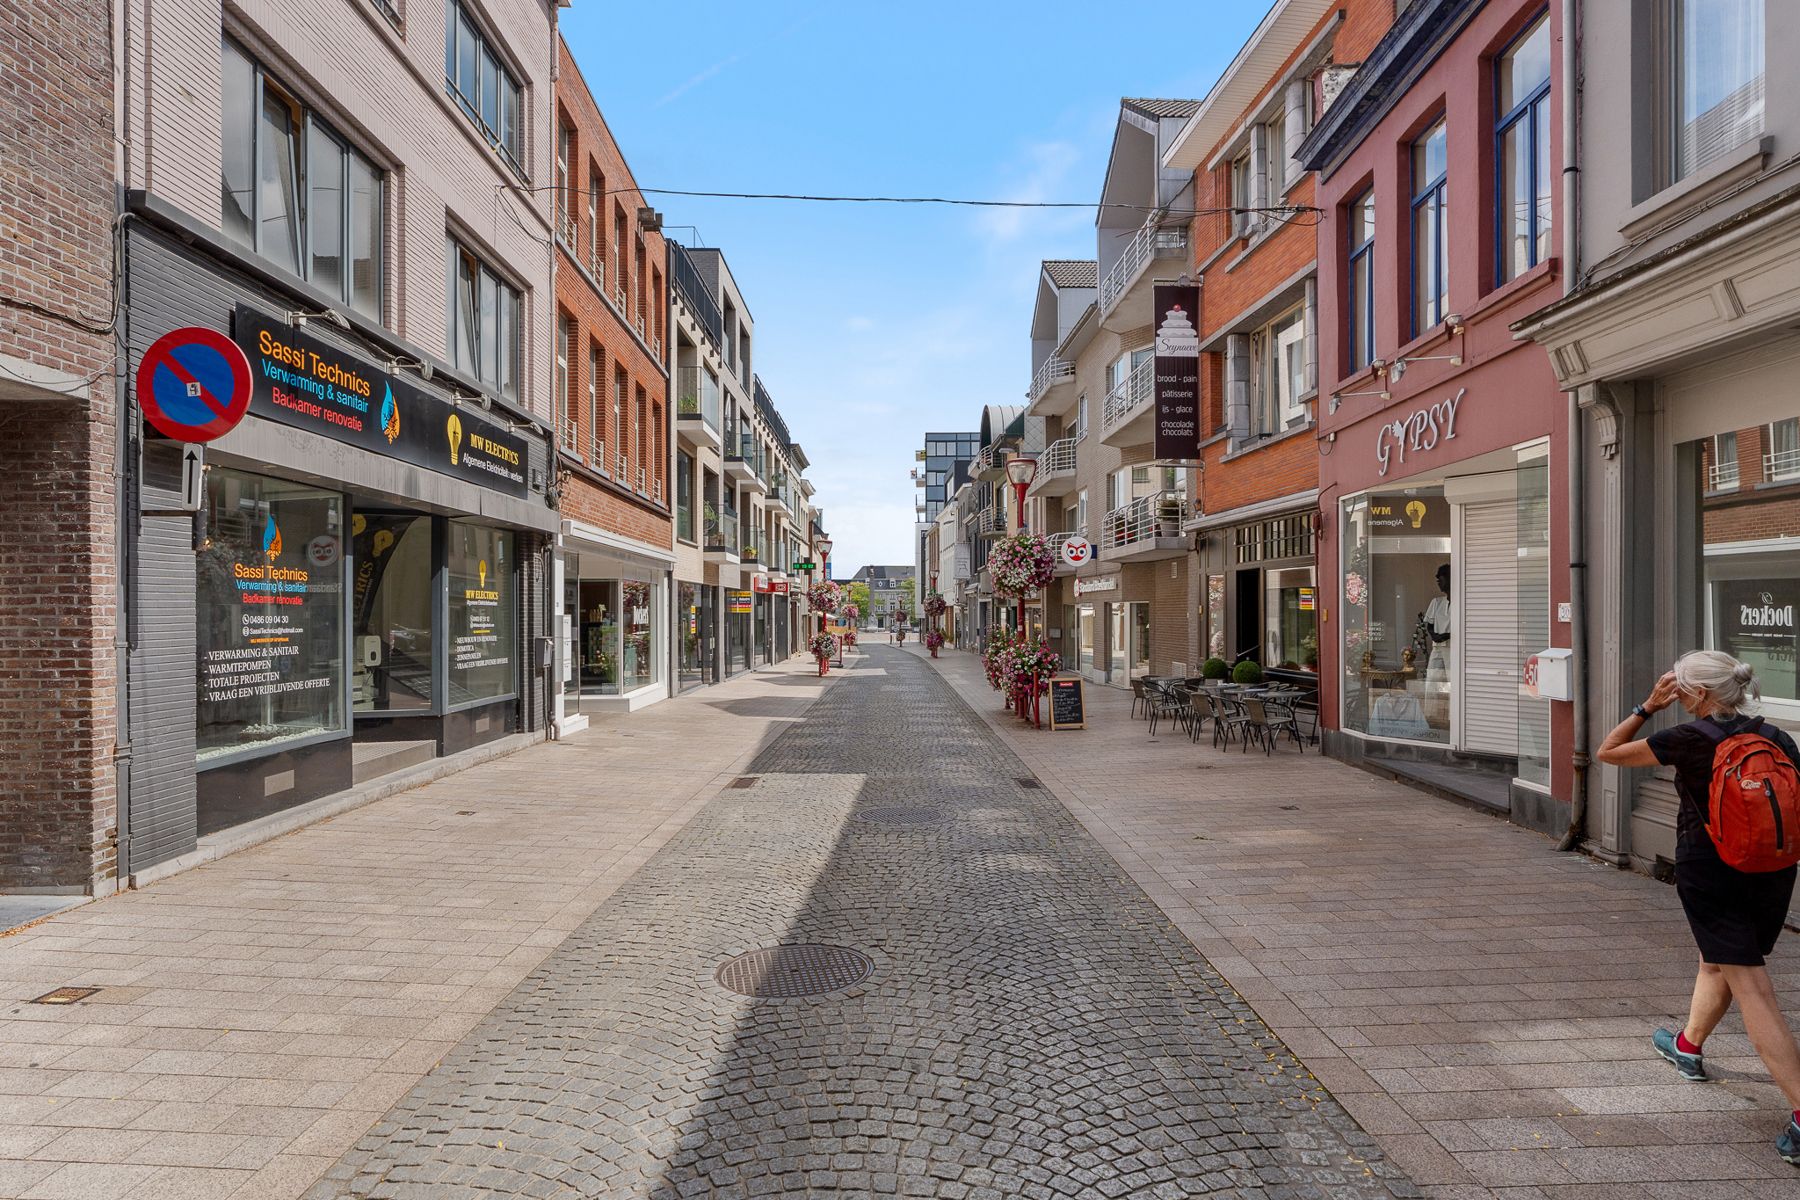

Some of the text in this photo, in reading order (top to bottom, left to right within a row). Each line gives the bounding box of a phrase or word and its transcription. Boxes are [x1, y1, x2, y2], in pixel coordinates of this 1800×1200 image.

[260, 330, 370, 397] Sassi Technics
[262, 358, 369, 413] Verwarming & sanitair
[1157, 375, 1177, 383] brood
[1183, 375, 1197, 384] pain
[1162, 390, 1193, 399] pâtisserie
[272, 386, 363, 432] Badkamer renovatie
[1176, 405, 1193, 414] glace
[1161, 420, 1194, 428] chocolade
[1162, 428, 1193, 436] chocolats
[1377, 388, 1465, 477] GYPSY
[470, 433, 519, 466] MW ELECTRICS
[463, 452, 486, 470] Algemene
[234, 563, 308, 582] Sassi Technics
[236, 580, 277, 592] Verwarming
[278, 581, 284, 591] &
[285, 581, 308, 593] sanitair
[242, 593, 303, 605] Badkamer renovatie
[274, 615, 281, 624] 04
[281, 615, 289, 624] 30
[209, 649, 261, 661] VERWARMING
[262, 649, 268, 657] &
[268, 646, 299, 657] SANITAIR
[209, 660, 272, 675] WARMTEPOMPEN
[209, 675, 239, 689] TOTALE
[240, 671, 280, 686] PROJECTEN
[209, 689, 238, 703] VRAAG
[238, 687, 253, 698] EEN
[254, 680, 304, 695] VRIJBLIJVENDE
[304, 677, 331, 689] OFFERTE
